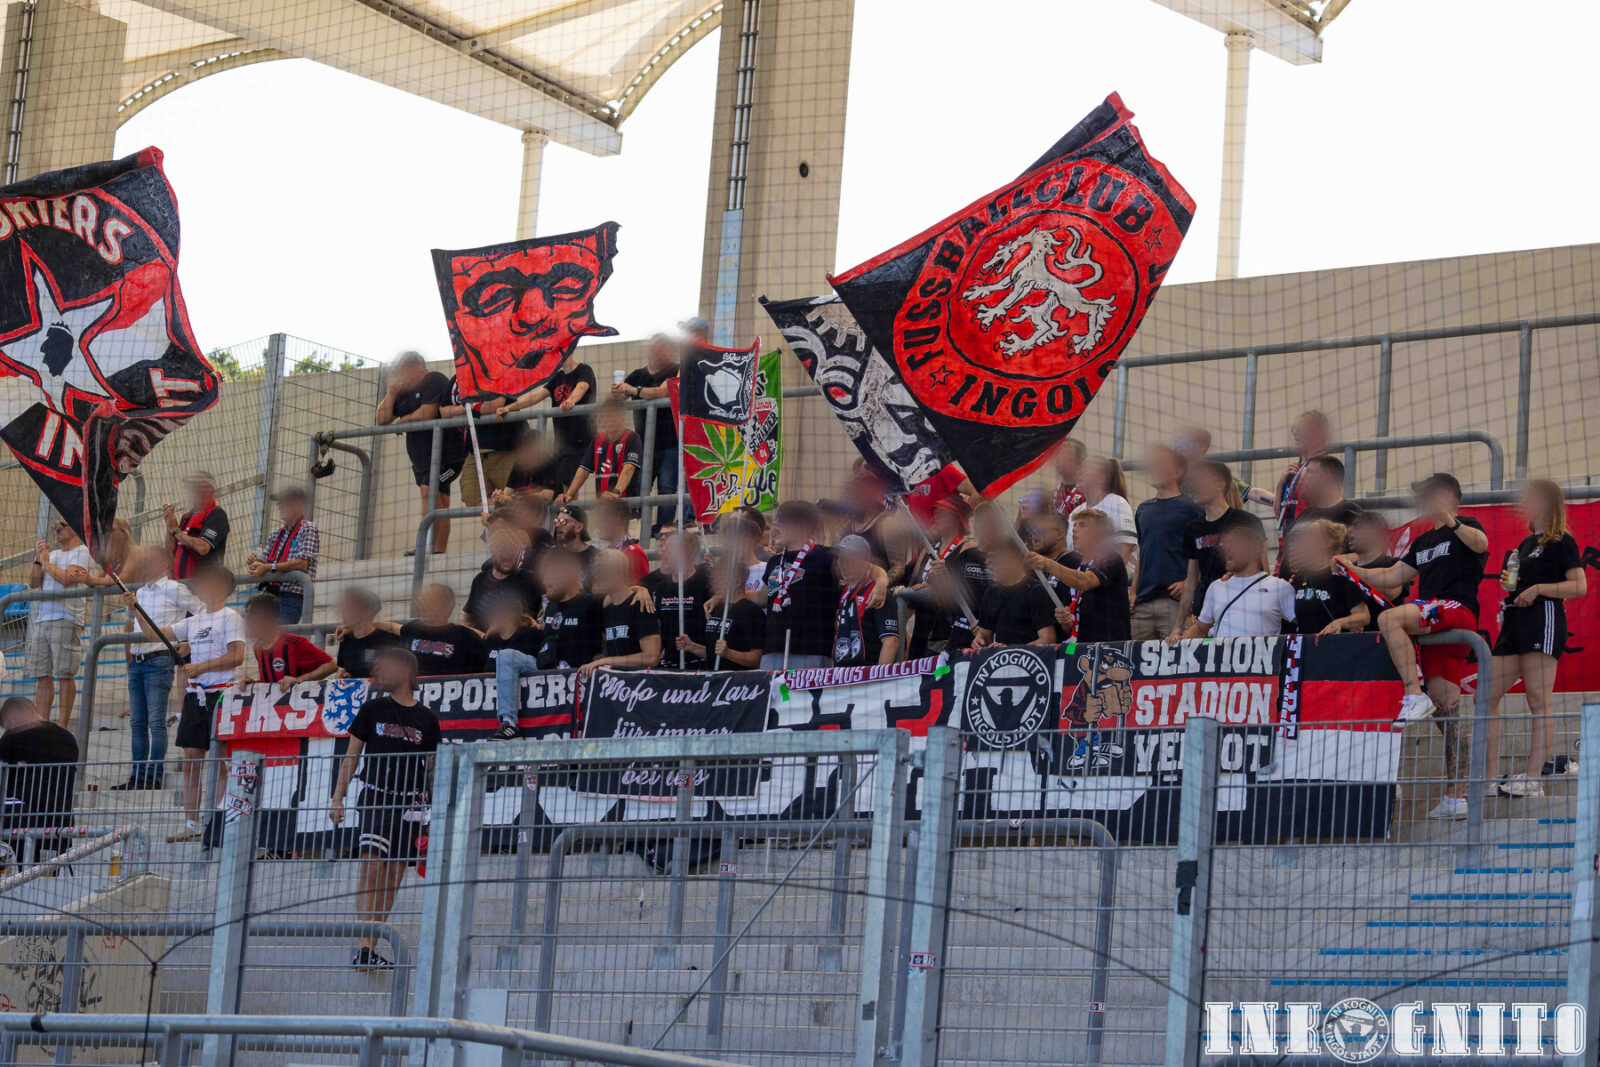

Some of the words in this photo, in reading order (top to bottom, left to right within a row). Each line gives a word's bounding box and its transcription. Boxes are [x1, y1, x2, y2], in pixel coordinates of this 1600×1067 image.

[976, 668, 990, 687] IN
[989, 652, 1047, 686] KOGNITO
[1140, 636, 1278, 677] SEKTION
[662, 681, 712, 704] und
[712, 677, 764, 707] Lars
[786, 666, 866, 690] SUPREMUS
[216, 681, 323, 735] FKS
[1134, 681, 1273, 726] STADION
[970, 708, 1042, 744] INGOLSTADT
[621, 762, 661, 785] bei
[665, 768, 710, 786] us
